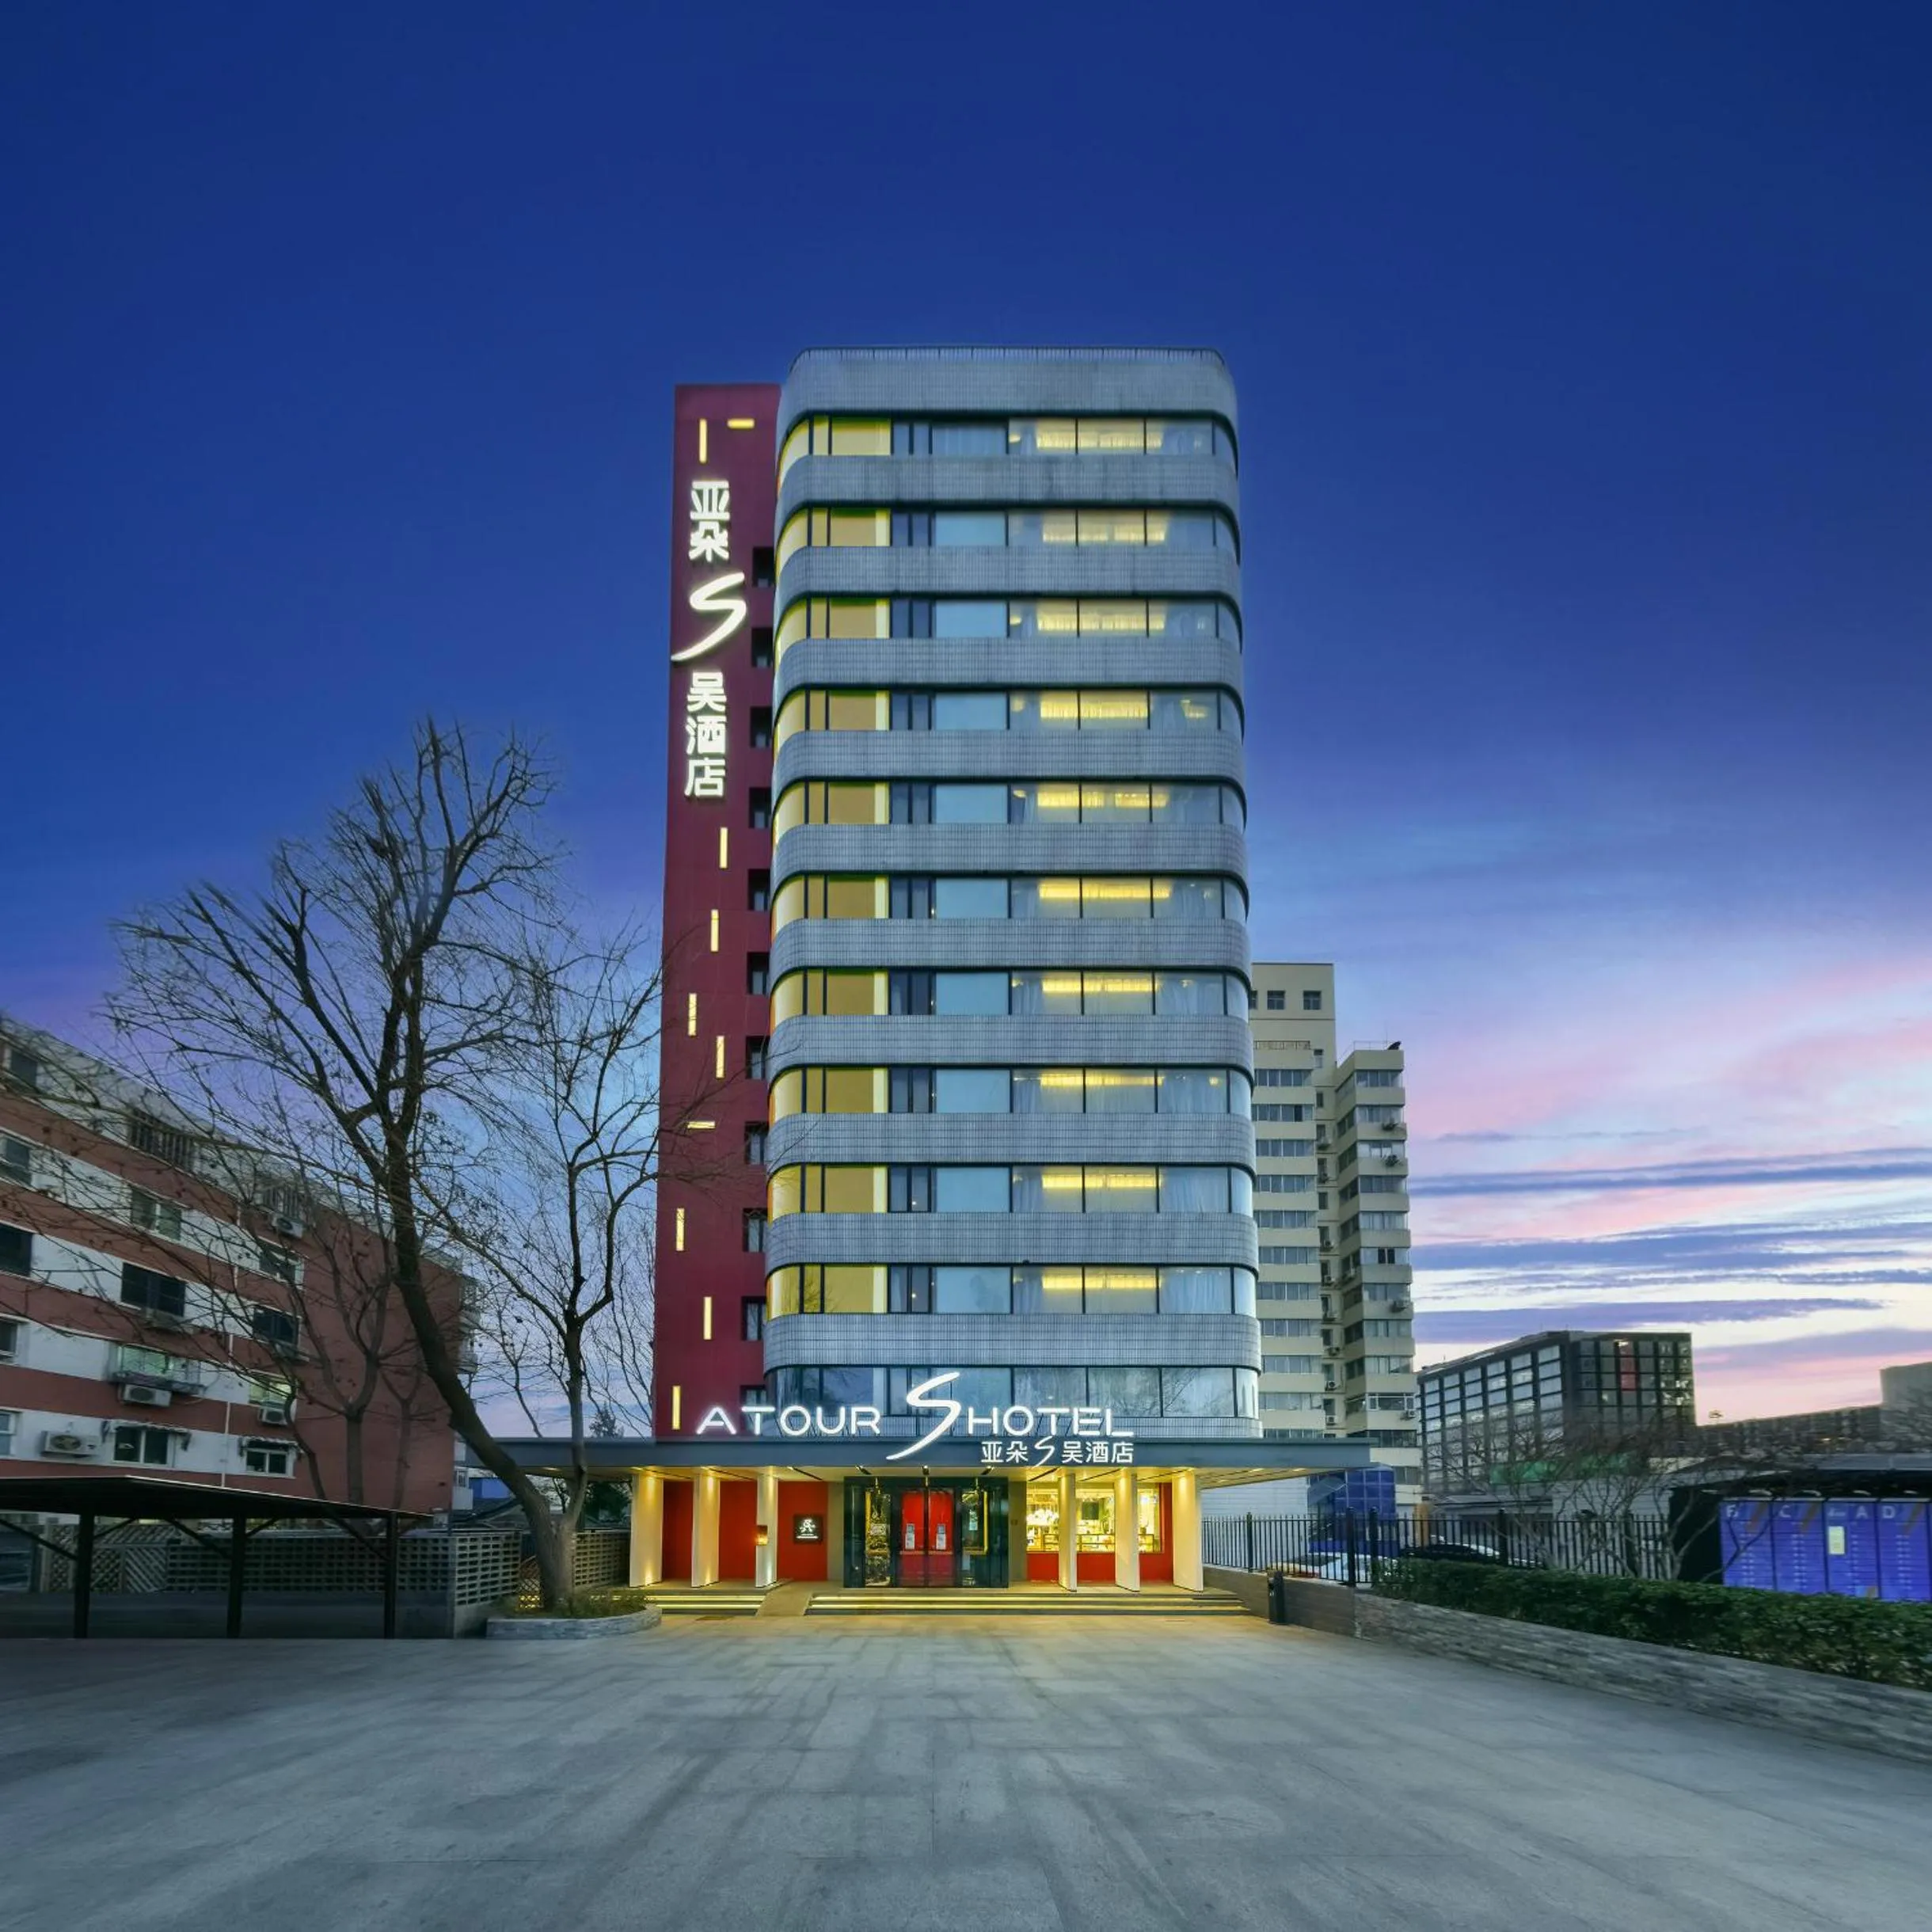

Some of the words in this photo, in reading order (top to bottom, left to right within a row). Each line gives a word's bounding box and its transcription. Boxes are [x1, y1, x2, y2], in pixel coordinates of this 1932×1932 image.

[696, 1405, 880, 1436] ATOUR
[886, 1371, 961, 1460] S
[968, 1405, 1134, 1437] HOTEL
[1856, 1505, 1868, 1519] A
[1882, 1505, 1896, 1519] D
